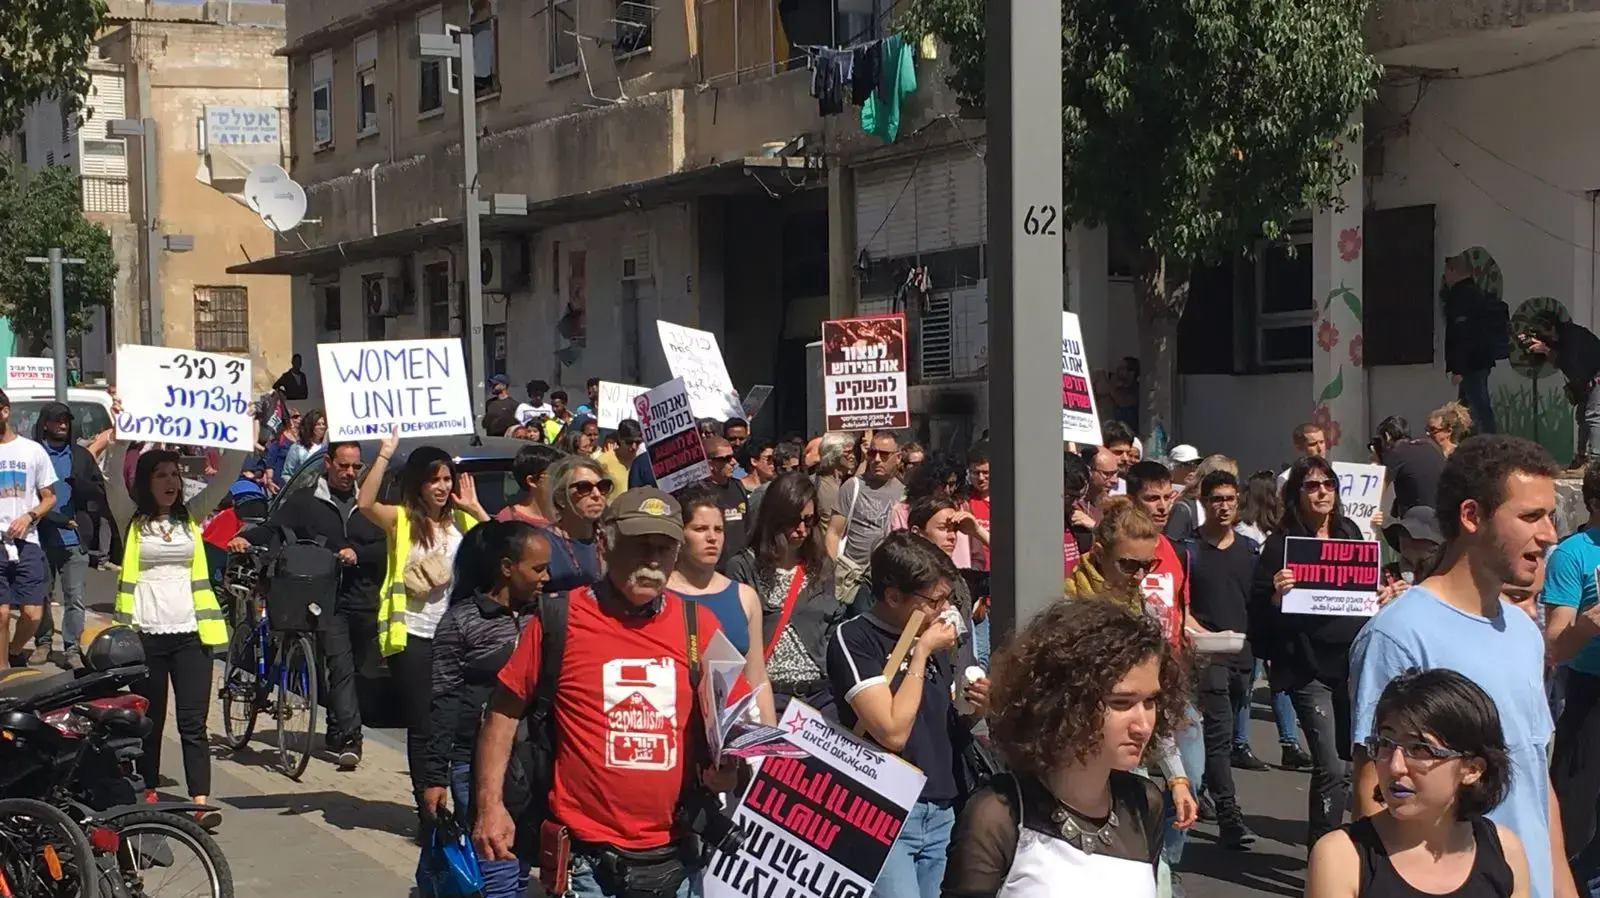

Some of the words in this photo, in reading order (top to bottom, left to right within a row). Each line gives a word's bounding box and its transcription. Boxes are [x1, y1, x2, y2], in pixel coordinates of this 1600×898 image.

[1024, 205, 1056, 235] 62
[331, 346, 450, 383] WOMEN
[841, 342, 887, 361] לעצור
[225, 360, 245, 384] יד
[831, 361, 877, 375] הגירוש
[879, 359, 899, 372] את
[835, 376, 897, 396] להשקיע
[164, 384, 248, 415] עוצרות
[351, 386, 447, 419] UNITE
[651, 393, 688, 420] נאבקות
[836, 395, 898, 411] בשכונות
[198, 418, 238, 443] את
[338, 423, 396, 436] AGAINST
[401, 416, 467, 433] DEPORTATION!
[645, 410, 693, 442] בסקסיזם
[1320, 542, 1378, 562] דורשות
[1337, 565, 1378, 587] שוויון
[608, 705, 664, 732] capitalism
[802, 730, 832, 752] מאבק
[829, 746, 879, 780] סוציאליסטי
[746, 779, 842, 850] דורשות
[761, 756, 833, 805] שוויון
[824, 783, 901, 847] ורווחה
